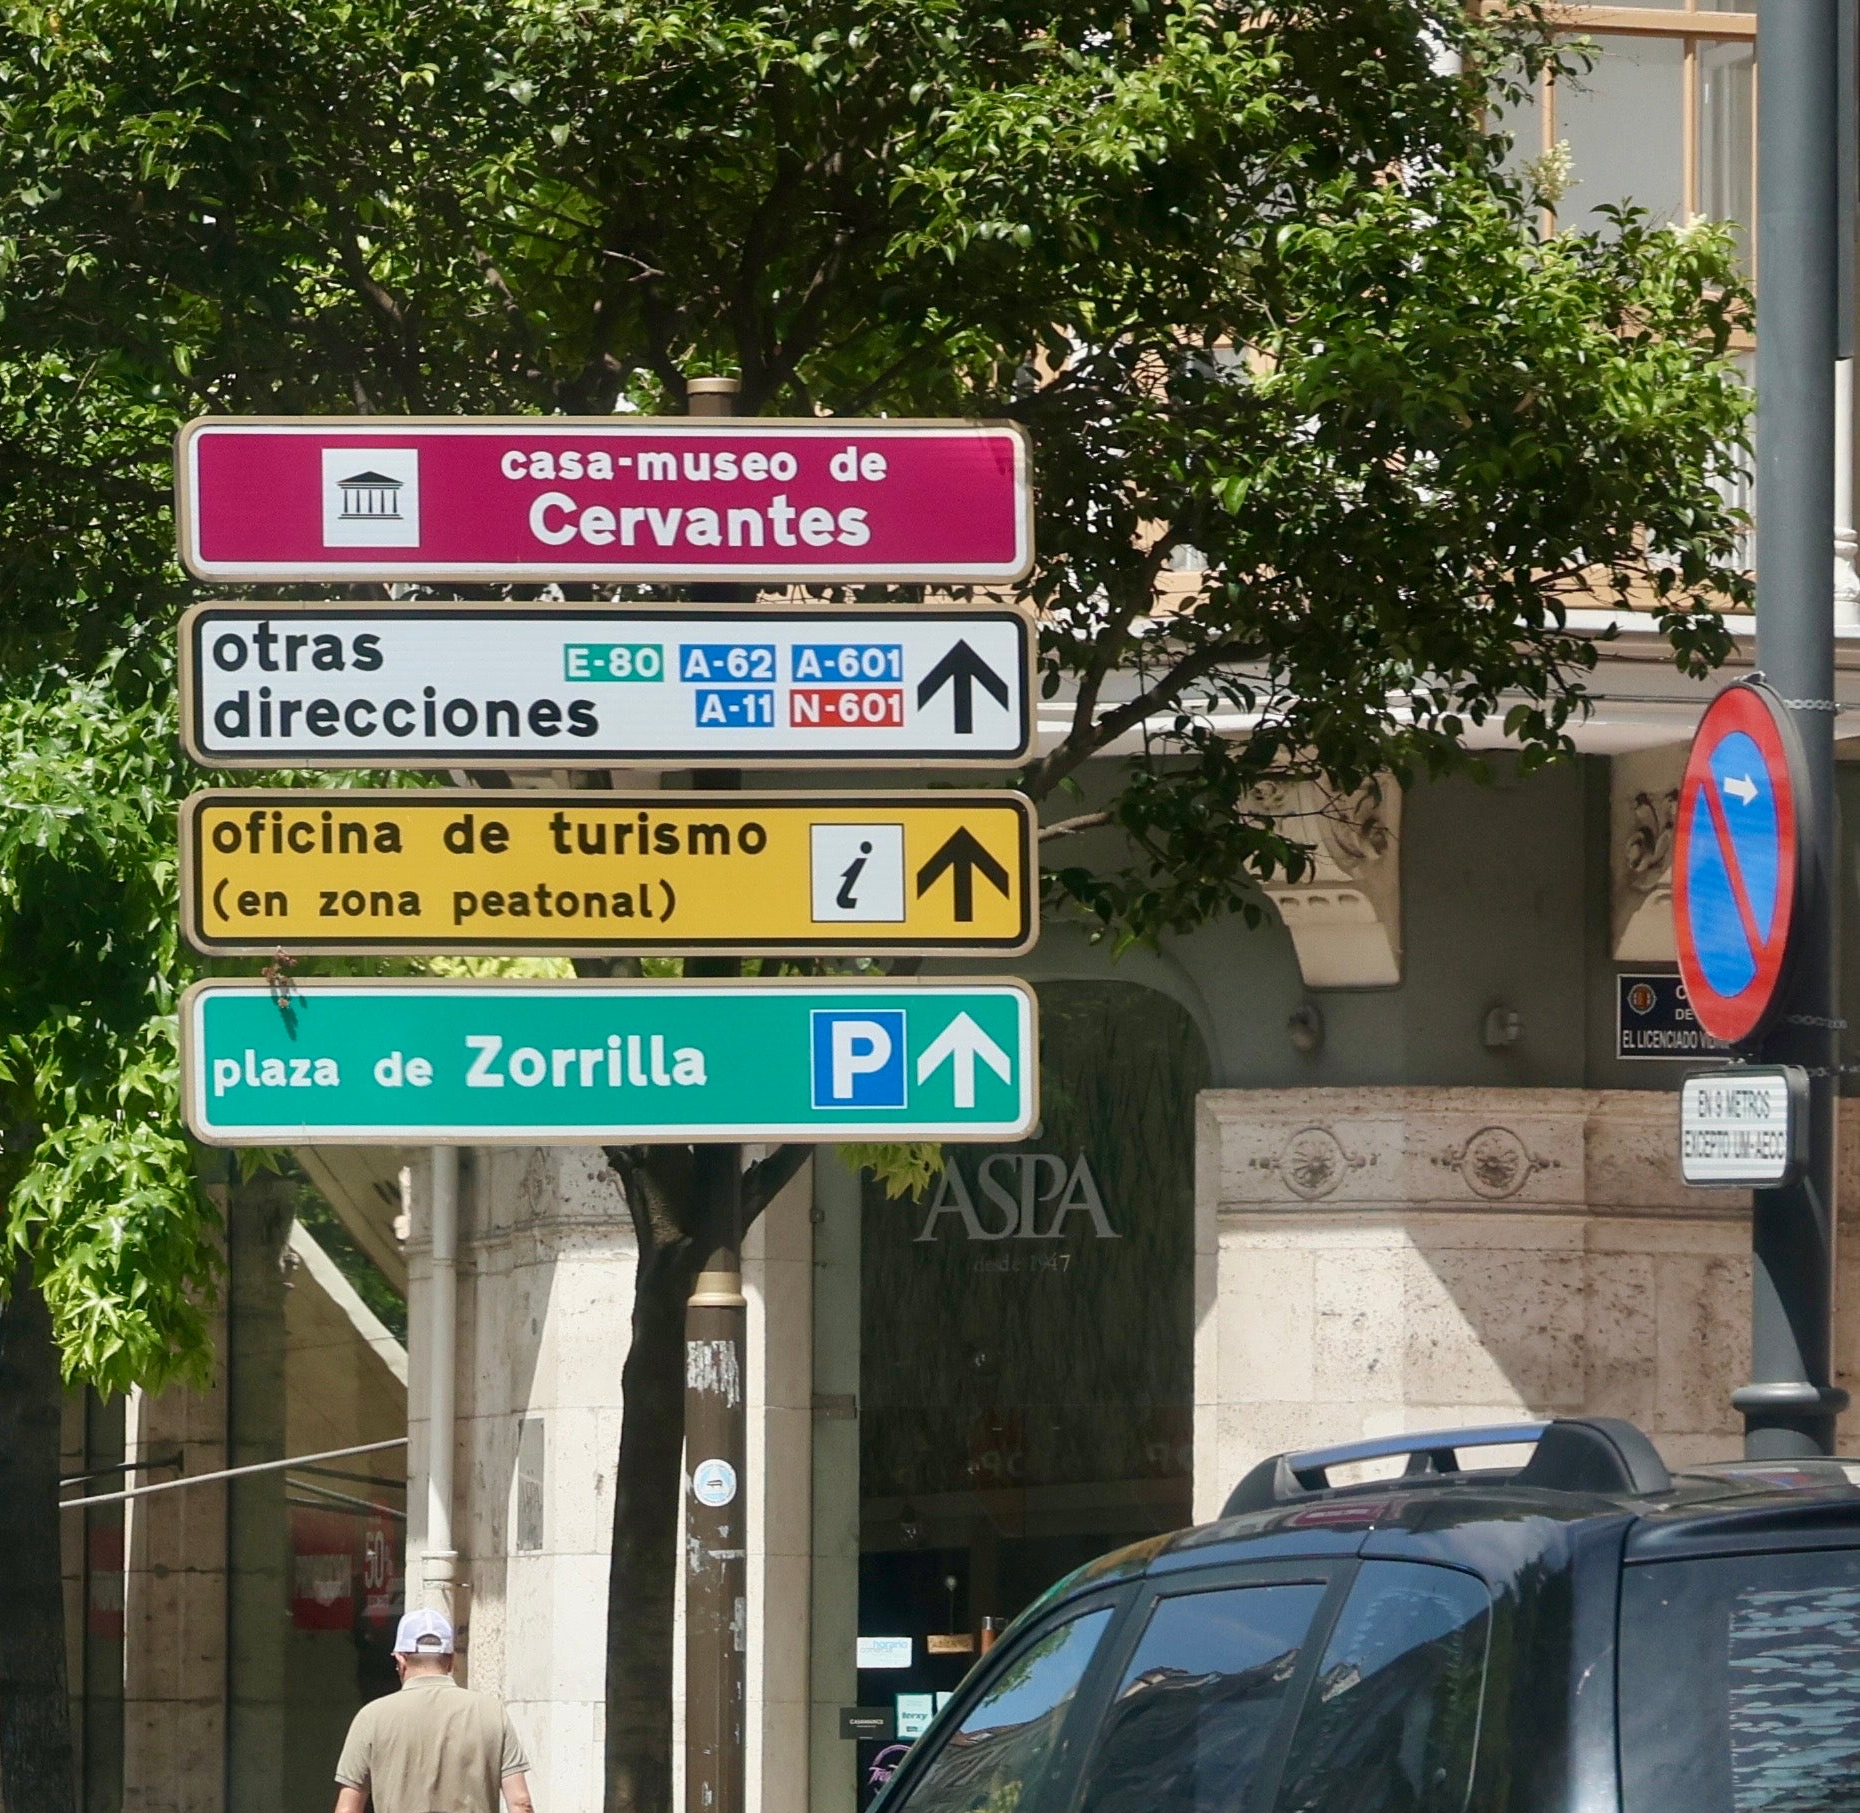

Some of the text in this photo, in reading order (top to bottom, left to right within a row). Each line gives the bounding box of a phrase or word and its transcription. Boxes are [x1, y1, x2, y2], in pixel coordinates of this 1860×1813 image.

[501, 446, 888, 482] casa-museo de
[529, 492, 872, 547] Cervantes
[212, 623, 385, 672] otras
[567, 648, 902, 679] E-80 A-62 A-601
[214, 689, 600, 738] direcciones
[700, 692, 903, 724] A-11 N-601
[212, 811, 768, 855] oficina de turismo
[212, 878, 678, 925] (en zona peatonal)
[831, 1020, 892, 1100] P
[1623, 1030, 1636, 1048] EL
[1637, 1030, 1698, 1048] LICENCIADO
[213, 1034, 708, 1097] plaza de Zorrilla
[1726, 1090, 1770, 1119] METROS
[1685, 1130, 1729, 1158] EXCEPTO
[913, 1152, 1123, 1241] ASPA
